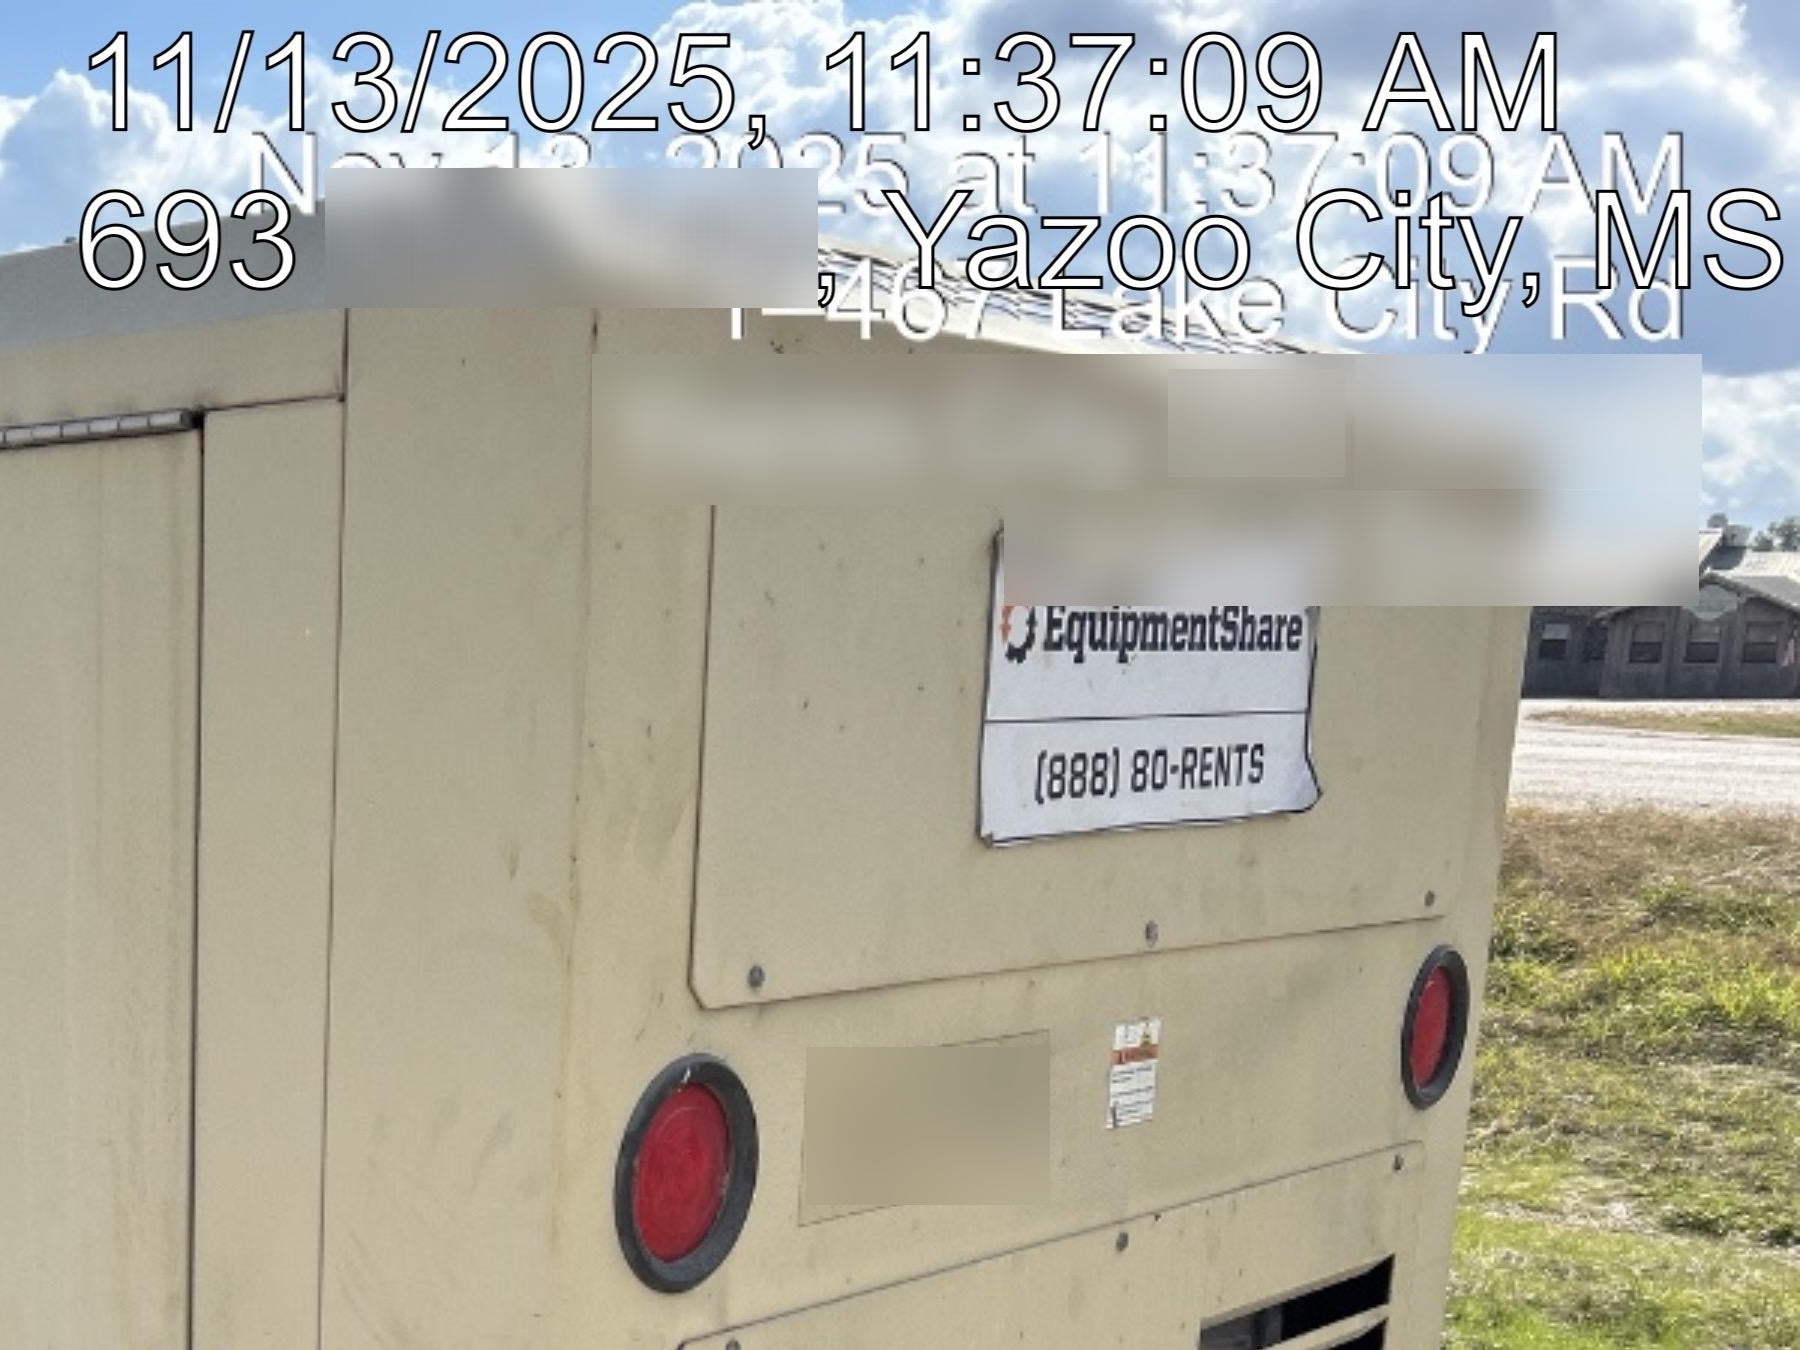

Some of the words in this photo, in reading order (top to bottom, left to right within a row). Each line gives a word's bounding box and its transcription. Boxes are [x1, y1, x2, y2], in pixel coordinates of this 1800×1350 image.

[1042, 605, 1303, 663] EquipmentShare
[1034, 748, 1120, 805] (888)
[1129, 743, 1265, 793] 80-RENTS
